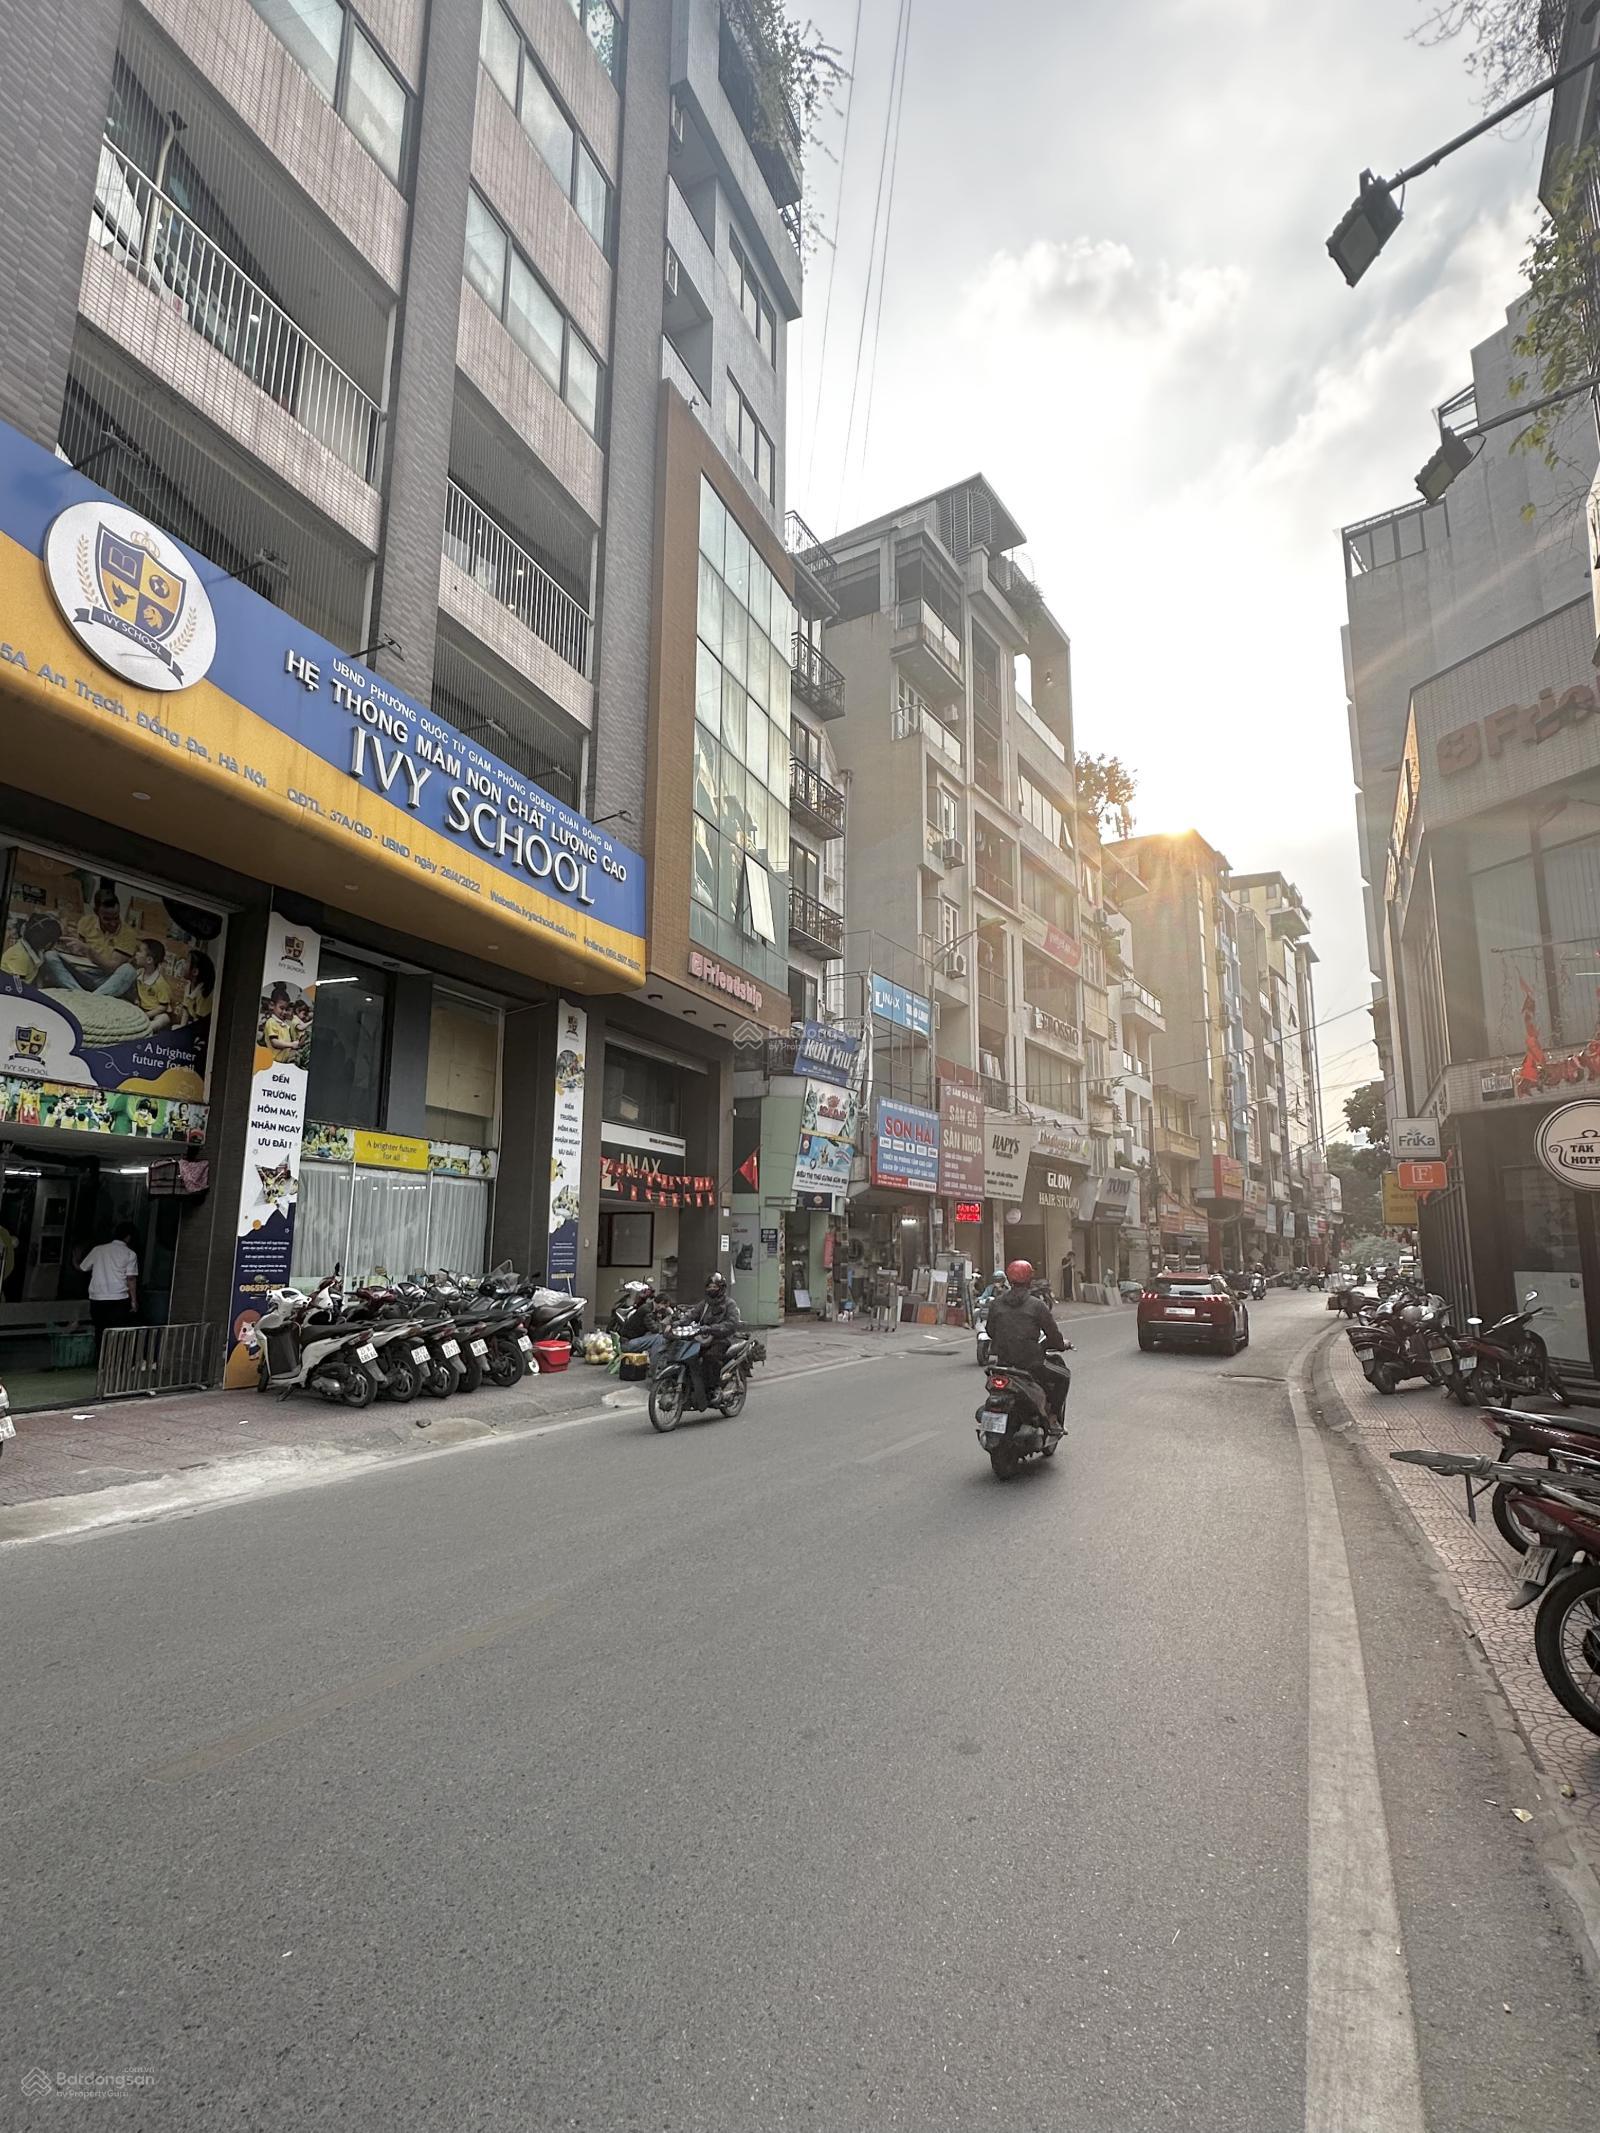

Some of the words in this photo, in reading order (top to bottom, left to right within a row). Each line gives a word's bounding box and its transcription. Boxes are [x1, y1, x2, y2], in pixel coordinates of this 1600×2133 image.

[103, 613, 121, 629] IVY
[121, 622, 162, 656] SCHOOL
[333, 658, 365, 688] UBND
[38, 663, 67, 689] An
[218, 752, 239, 774] Hà
[244, 765, 267, 788] Nội
[285, 649, 320, 691] HỆ
[331, 678, 408, 743] THỐNG
[466, 767, 501, 805] NON
[508, 795, 547, 832] CHẤT
[550, 822, 598, 864] LƯỢNG
[601, 855, 627, 882] CAO
[350, 725, 432, 809] IVY
[445, 785, 595, 906] SCHOOL
[381, 834, 410, 858] UBND
[414, 854, 438, 874] ngày
[703, 957, 762, 1012] Friendship
[132, 1053, 164, 1068] future
[144, 1043, 153, 1052] A
[156, 1045, 196, 1062] brighter
[4, 1063, 16, 1071] IVY
[17, 1065, 49, 1076] SCHOOL
[271, 1074, 290, 1085] ĐẾN
[262, 1088, 297, 1102] TRƯỜNG
[257, 1104, 278, 1115] HÔM
[279, 1108, 298, 1119] NAY,
[251, 1120, 276, 1133] NHẬN
[278, 1123, 301, 1134] NGAY
[373, 1141, 398, 1152] brighter
[399, 1145, 417, 1154] future
[1570, 1145, 1594, 1153] TAK
[382, 1152, 392, 1160] for
[1047, 1172, 1072, 1191] GLOW
[1039, 1191, 1056, 1207] HAIR
